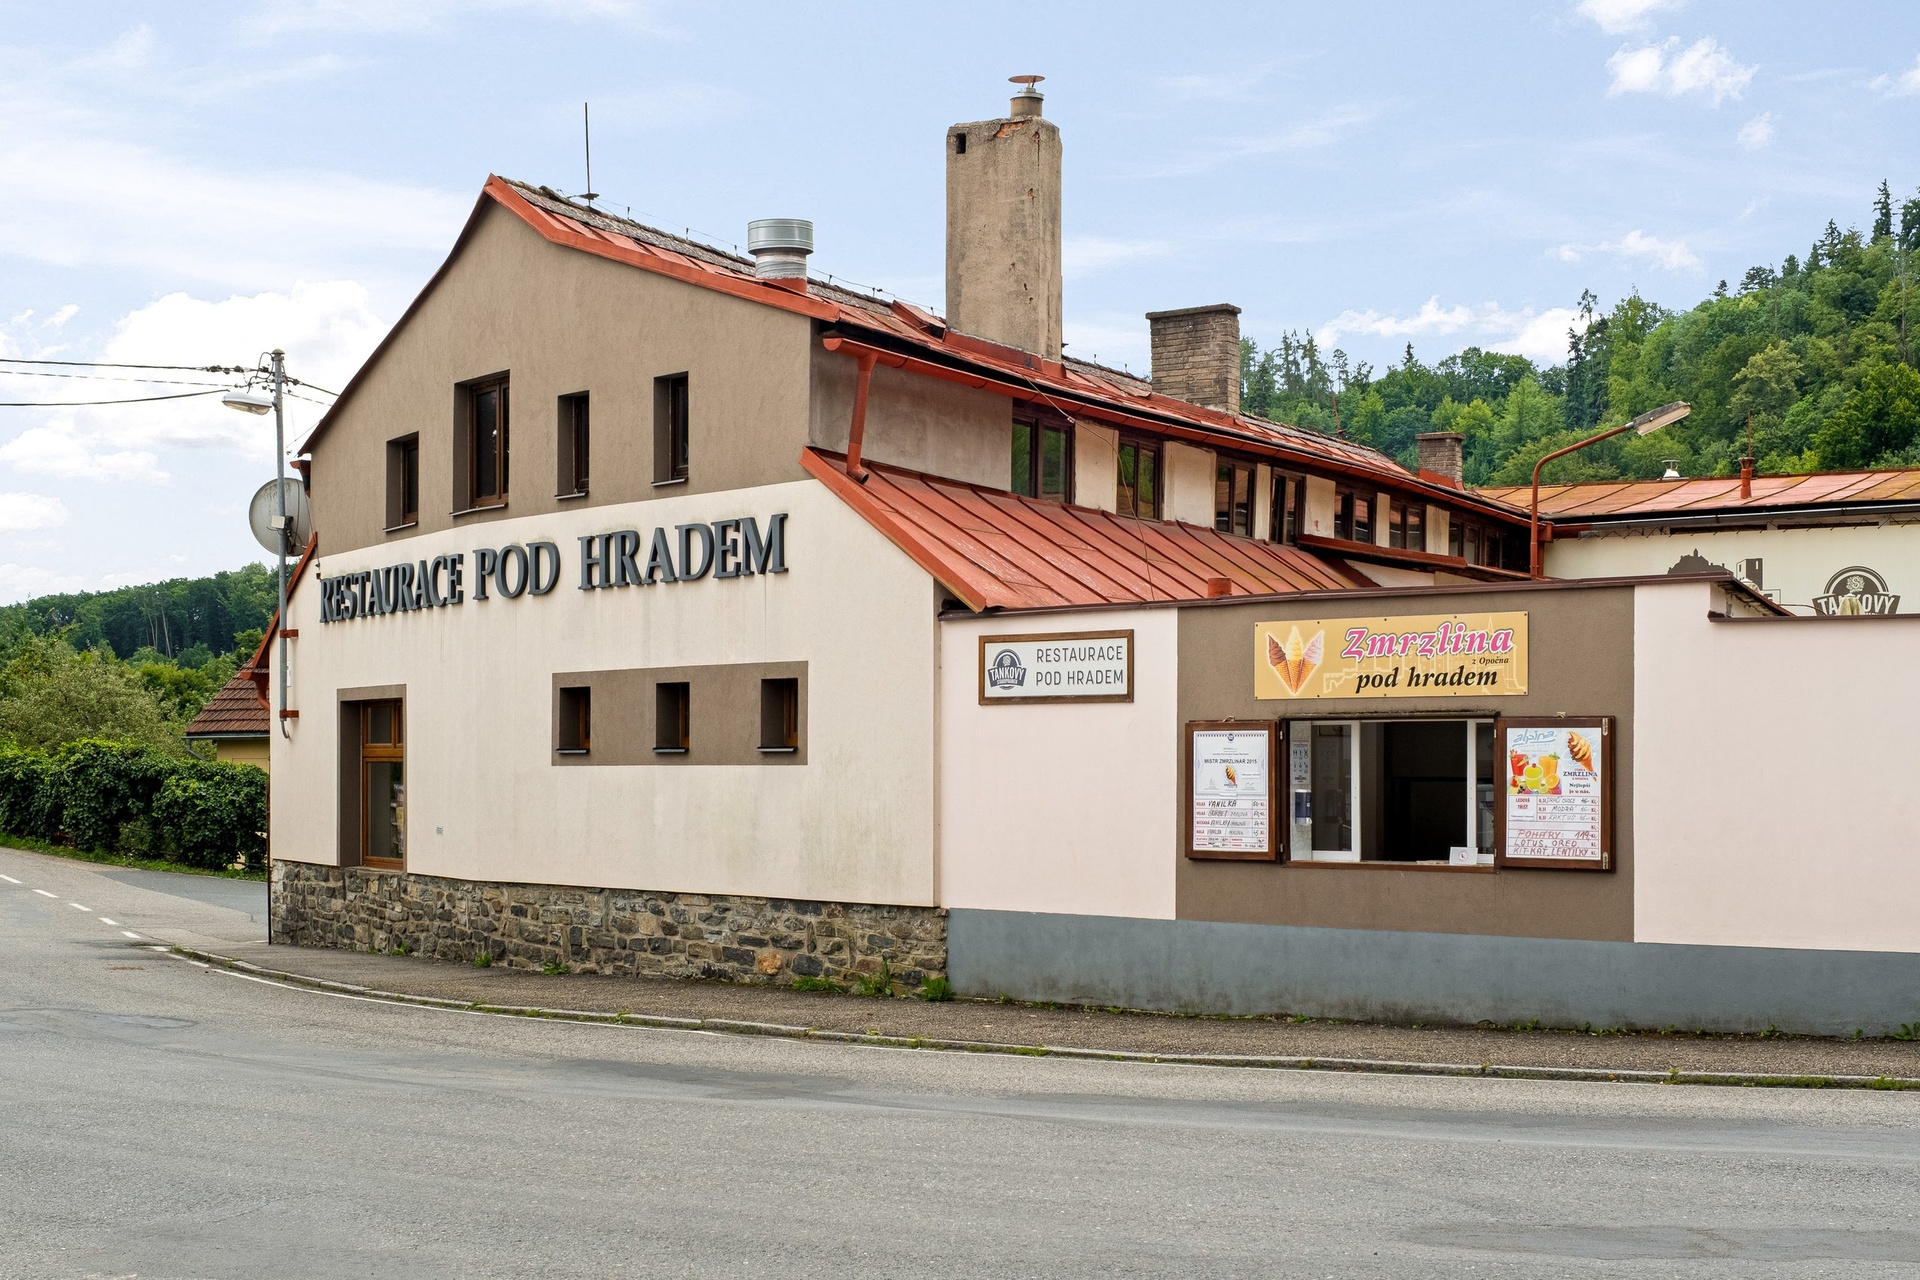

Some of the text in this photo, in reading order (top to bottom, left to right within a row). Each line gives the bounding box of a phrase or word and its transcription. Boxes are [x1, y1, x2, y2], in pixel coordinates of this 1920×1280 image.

[320, 513, 789, 623] RESTAURACE POD HRADEM
[1341, 621, 1514, 662] Zmrzlina
[1036, 645, 1123, 663] RESTAURACE
[1479, 656, 1510, 666] Opočna
[1036, 669, 1124, 686] POD HRADEM
[1355, 665, 1498, 694] pod hradem
